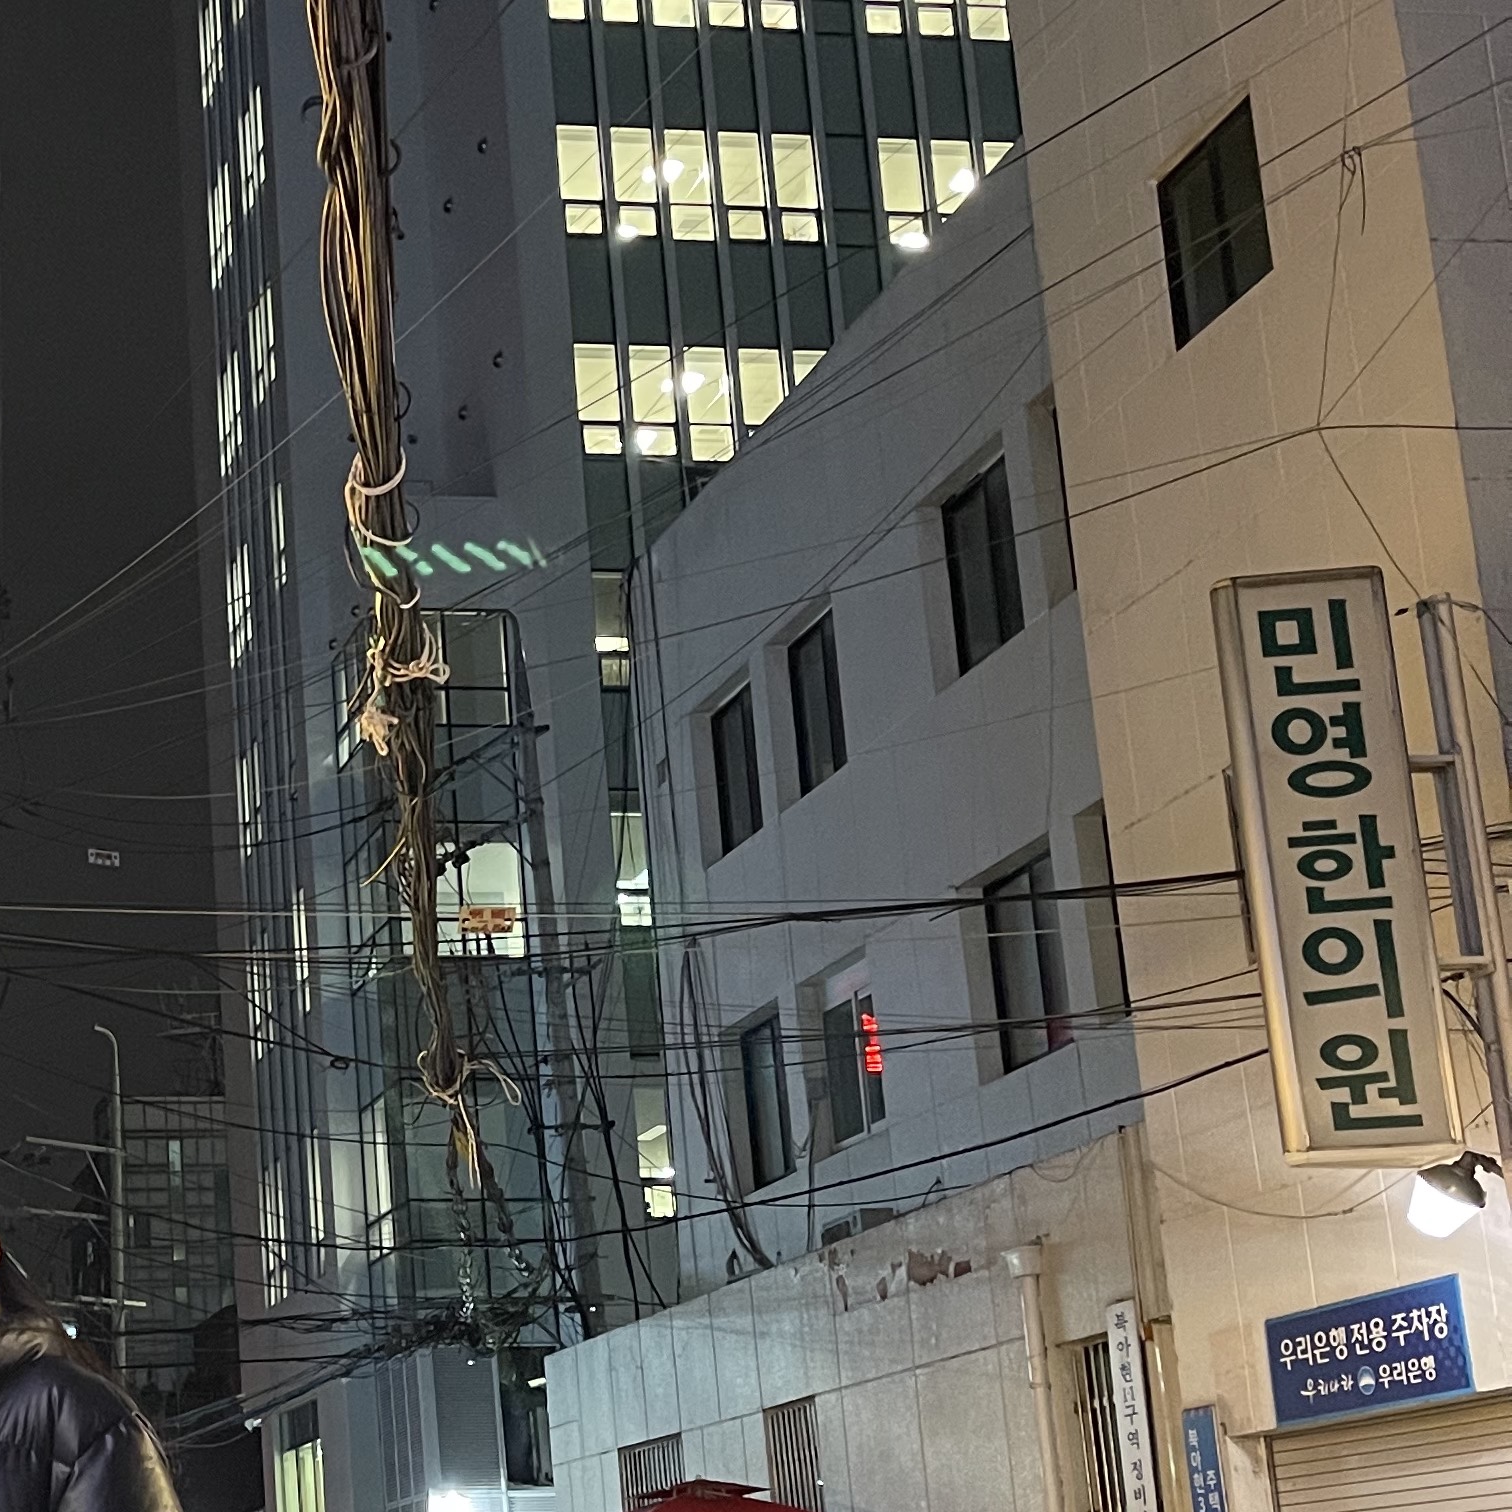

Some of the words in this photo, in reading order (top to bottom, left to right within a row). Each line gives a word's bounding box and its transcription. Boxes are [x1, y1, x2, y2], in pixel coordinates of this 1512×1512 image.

[1256, 597, 1424, 1133] 민영한의원
[1279, 1325, 1349, 1371] 우리은행
[1349, 1317, 1388, 1356] 전용
[1390, 1302, 1450, 1348] 주차장
[1299, 1373, 1355, 1405] 우리나라
[1378, 1354, 1437, 1390] 우리은행
